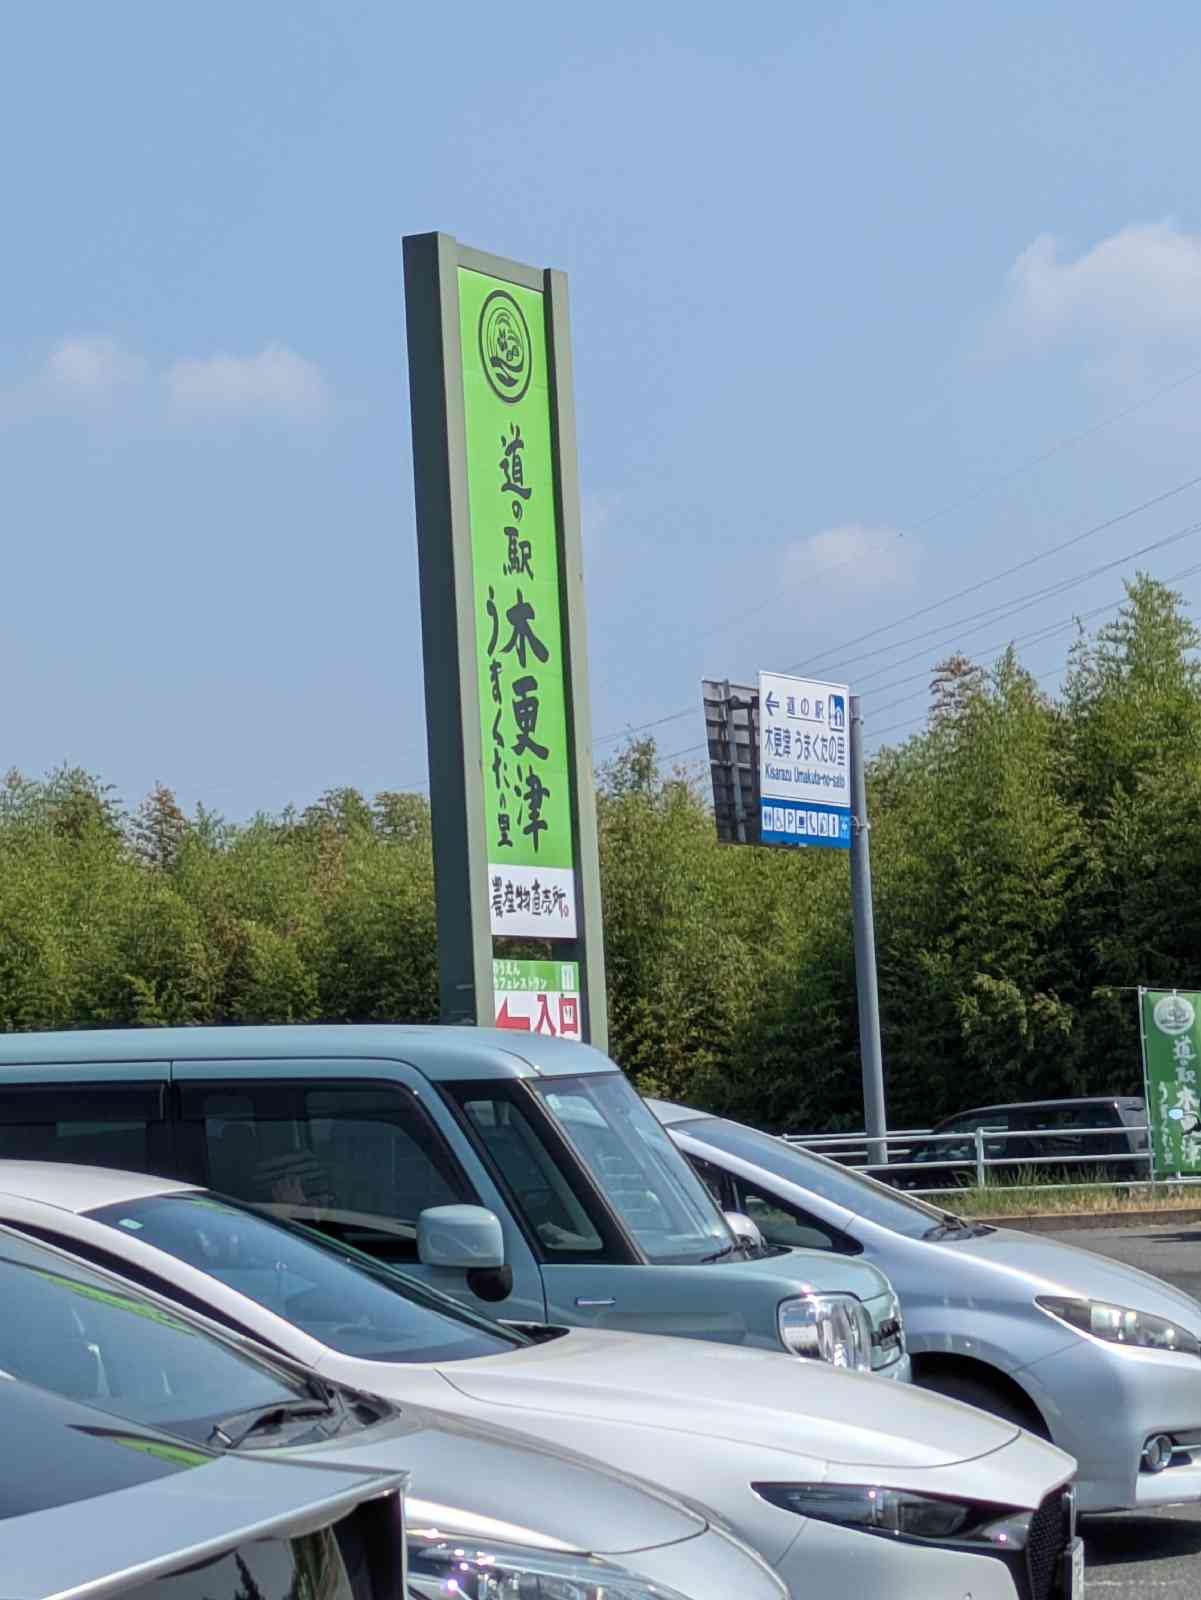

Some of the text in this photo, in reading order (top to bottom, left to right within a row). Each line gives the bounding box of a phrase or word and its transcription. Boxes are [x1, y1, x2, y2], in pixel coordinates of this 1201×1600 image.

[786, 696, 824, 719] 道の駅
[535, 994, 578, 1036] 入口
